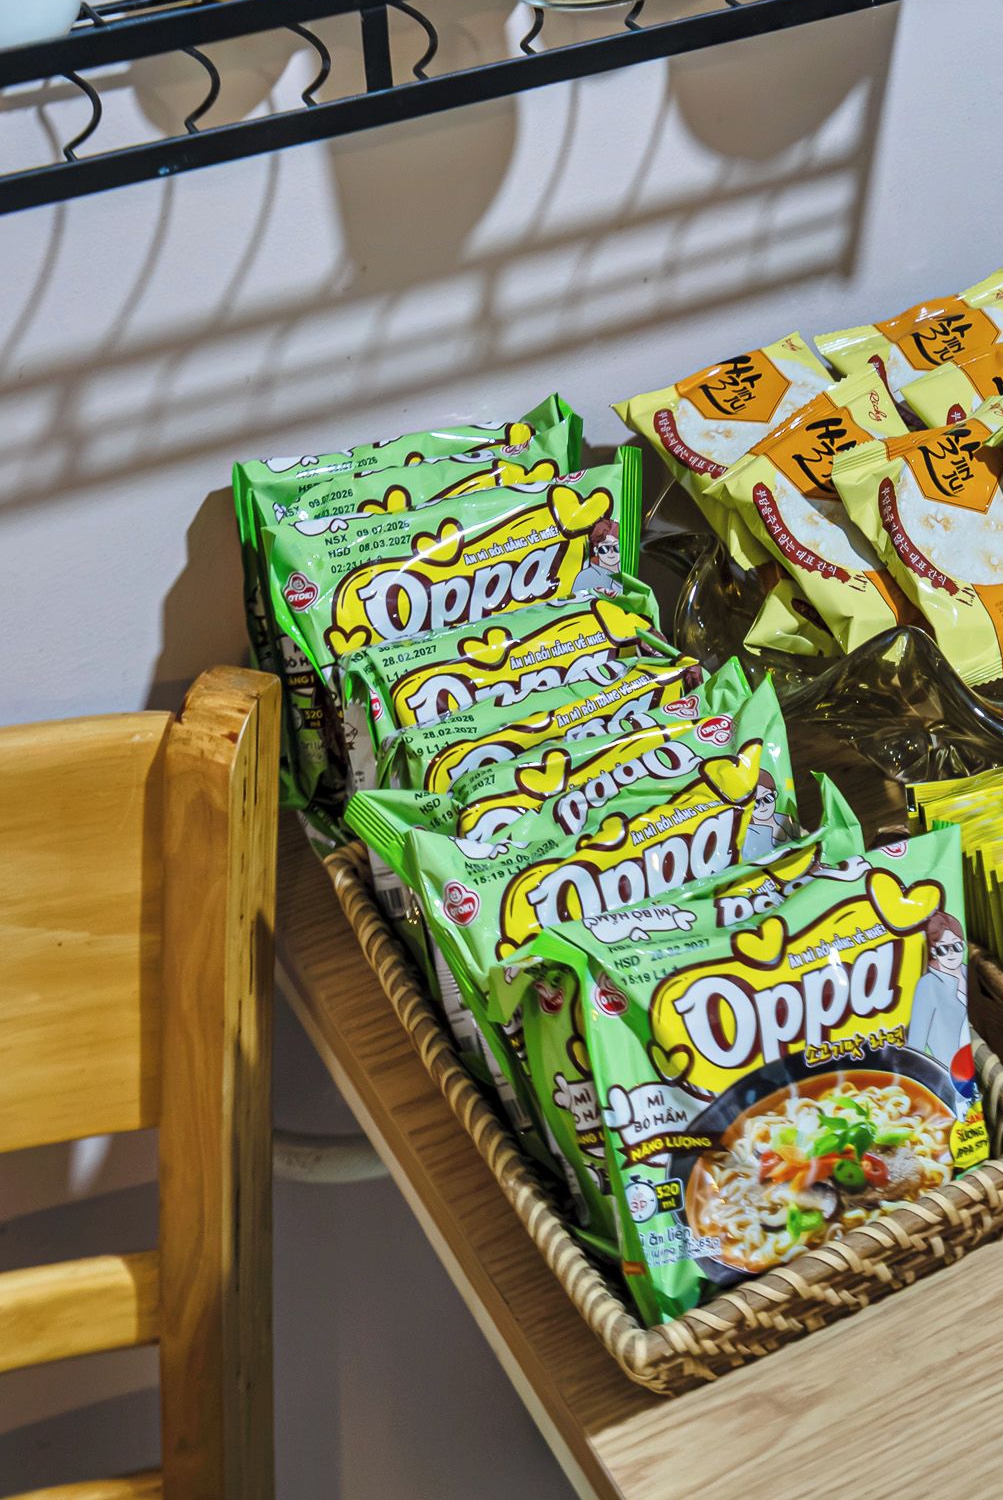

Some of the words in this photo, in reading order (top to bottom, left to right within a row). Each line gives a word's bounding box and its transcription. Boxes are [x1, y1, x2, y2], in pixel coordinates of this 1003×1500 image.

[732, 386, 756, 402] JIN
[951, 457, 975, 481] JIN
[325, 534, 348, 546] NSX
[356, 519, 411, 538] 09.07.2026
[328, 546, 351, 559] HSD
[359, 534, 412, 553] 08.03.2027
[287, 591, 314, 603] OTOKI
[358, 543, 561, 640] Oppa
[382, 645, 437, 668] 28.02.2027
[423, 726, 478, 740] 28.02.2027
[420, 798, 441, 815] HSD
[526, 809, 734, 928] Oppa
[613, 955, 641, 969] HSD
[673, 941, 894, 1069] Oppa
[647, 1091, 665, 1108] MÌ
[654, 1107, 688, 1124] HẦM
[630, 1139, 664, 1162] NĂNG
[664, 1135, 713, 1151] LƯỢNG
[655, 1183, 680, 1198] 320
[662, 1199, 677, 1209] ml
